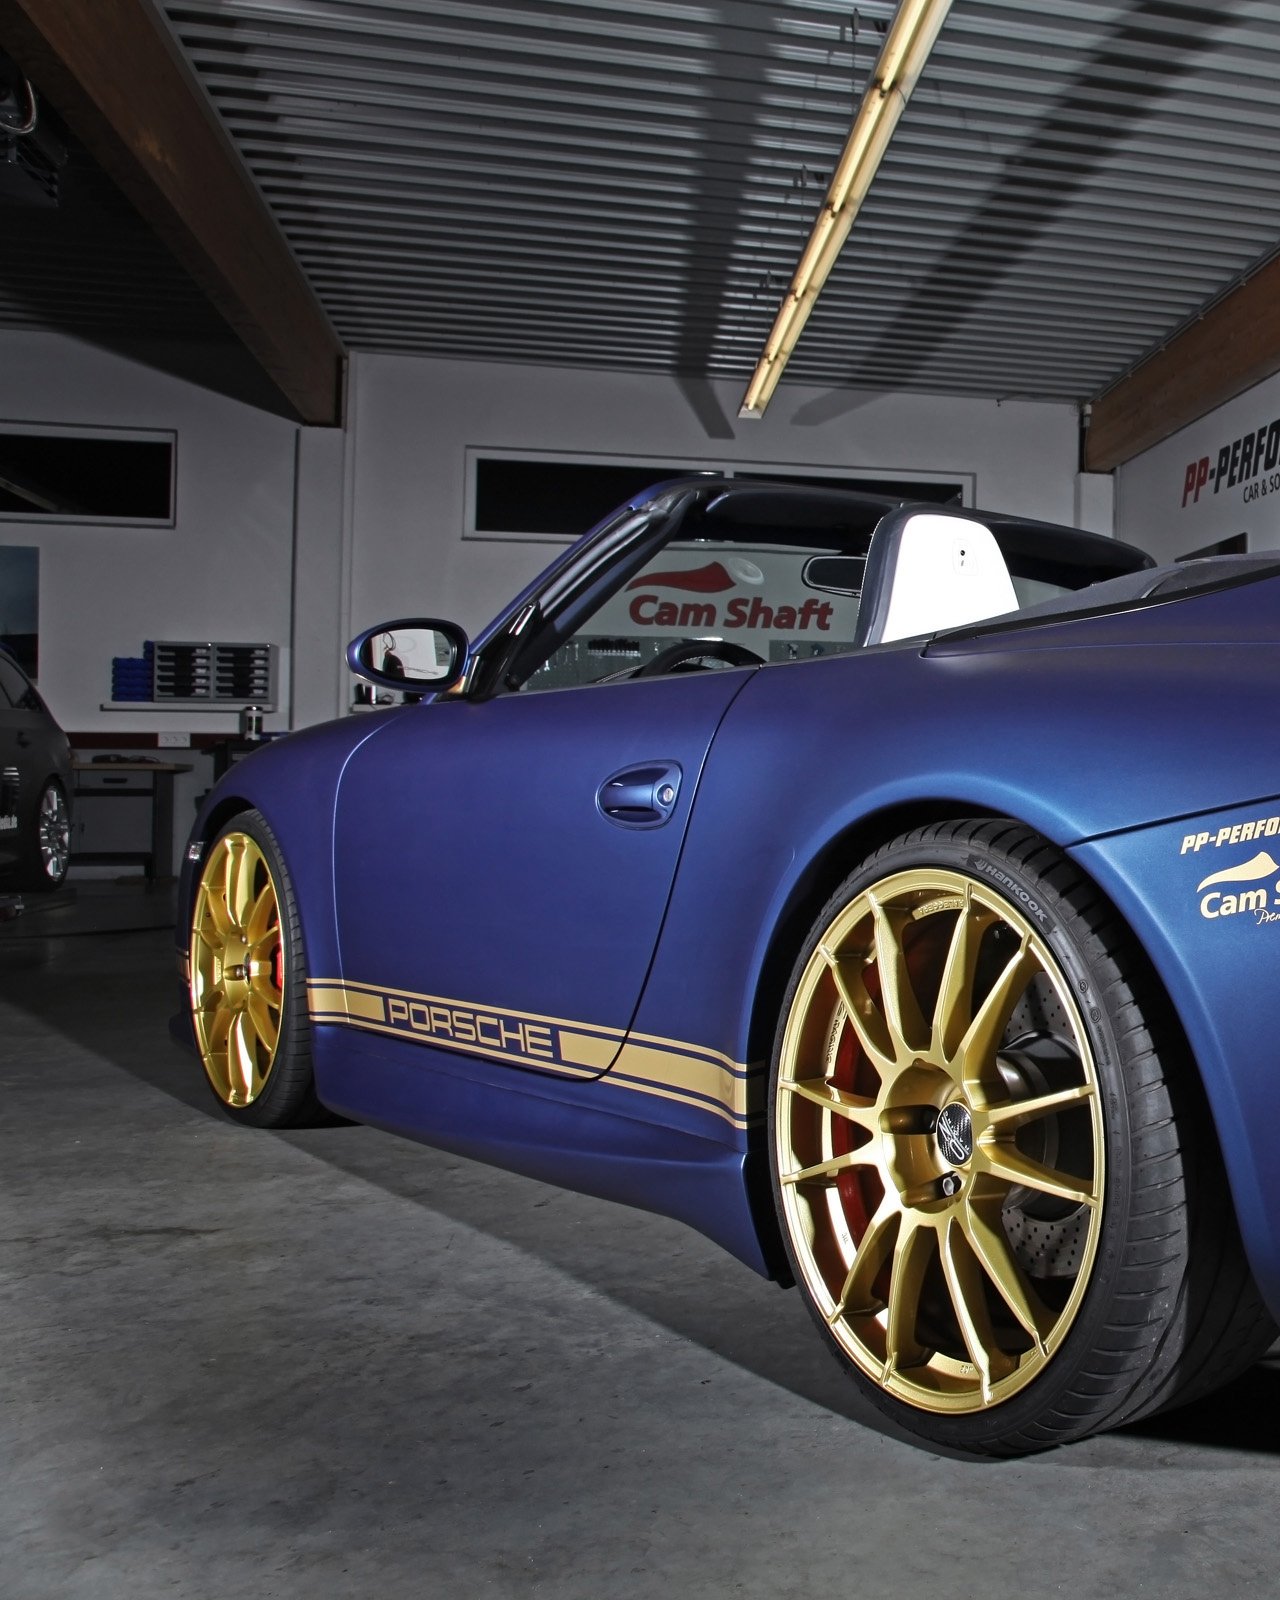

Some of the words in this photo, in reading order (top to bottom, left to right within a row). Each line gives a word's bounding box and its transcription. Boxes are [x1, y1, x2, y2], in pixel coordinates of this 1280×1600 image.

[1243, 479, 1259, 503] CAR
[1261, 478, 1268, 496] &
[629, 594, 717, 626] Cam
[723, 597, 833, 631] Shaft
[1200, 887, 1267, 919] Cam
[388, 998, 554, 1058] PORSCHE
